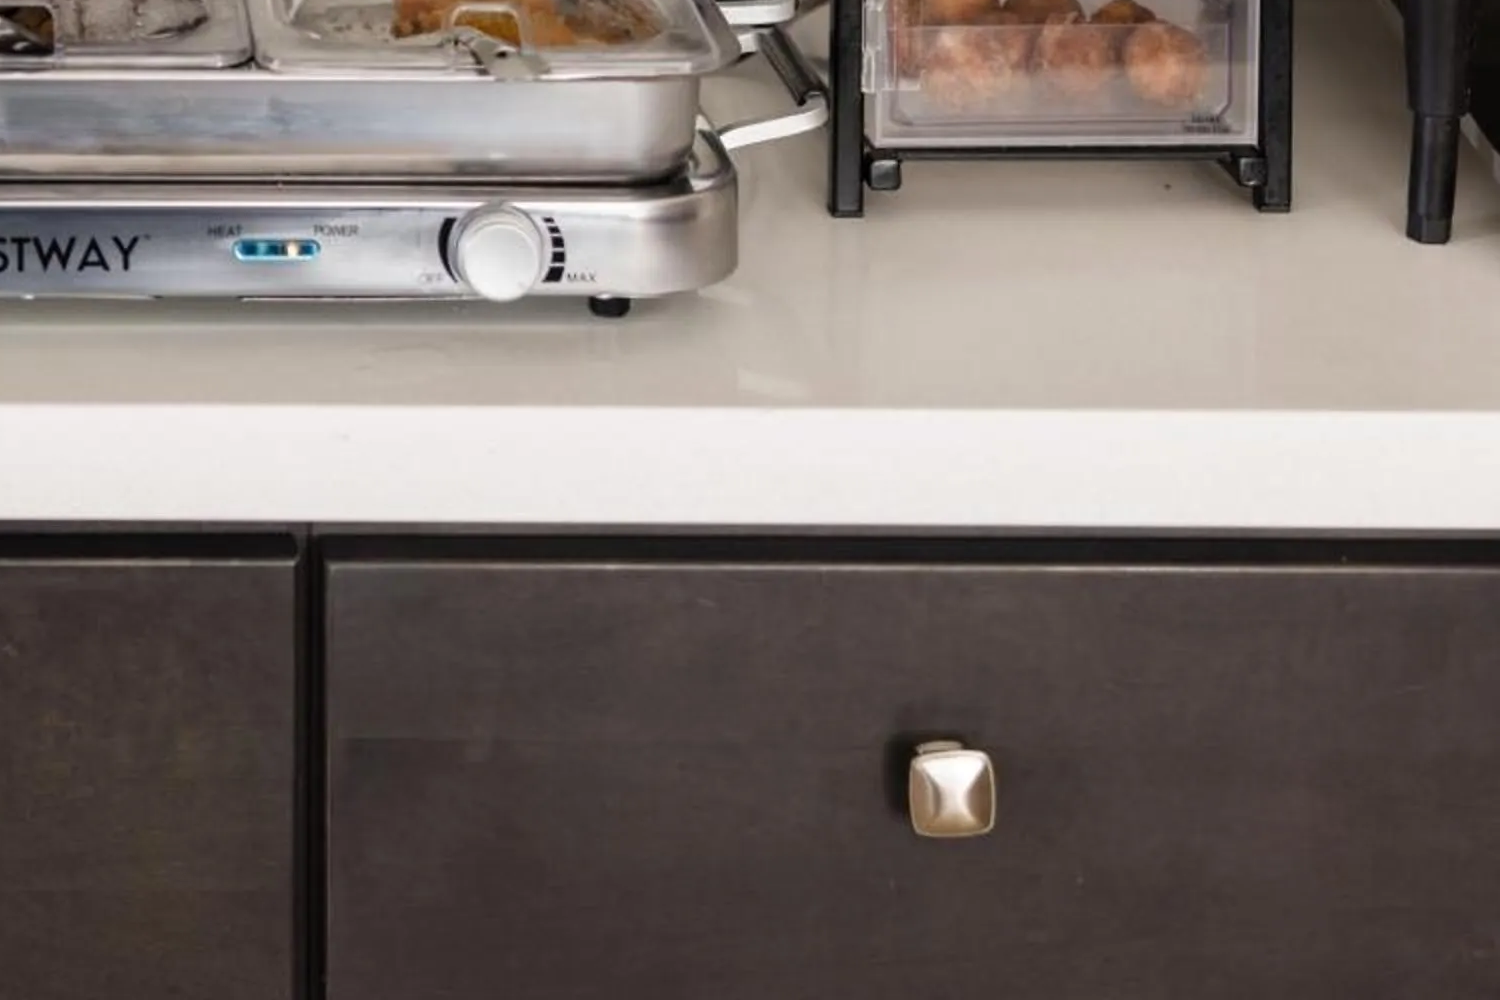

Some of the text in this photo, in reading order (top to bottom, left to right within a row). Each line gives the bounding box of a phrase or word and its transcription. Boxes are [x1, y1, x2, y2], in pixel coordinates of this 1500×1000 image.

[207, 224, 243, 238] HEAT
[313, 224, 359, 237] POWER
[567, 273, 597, 283] MAX
